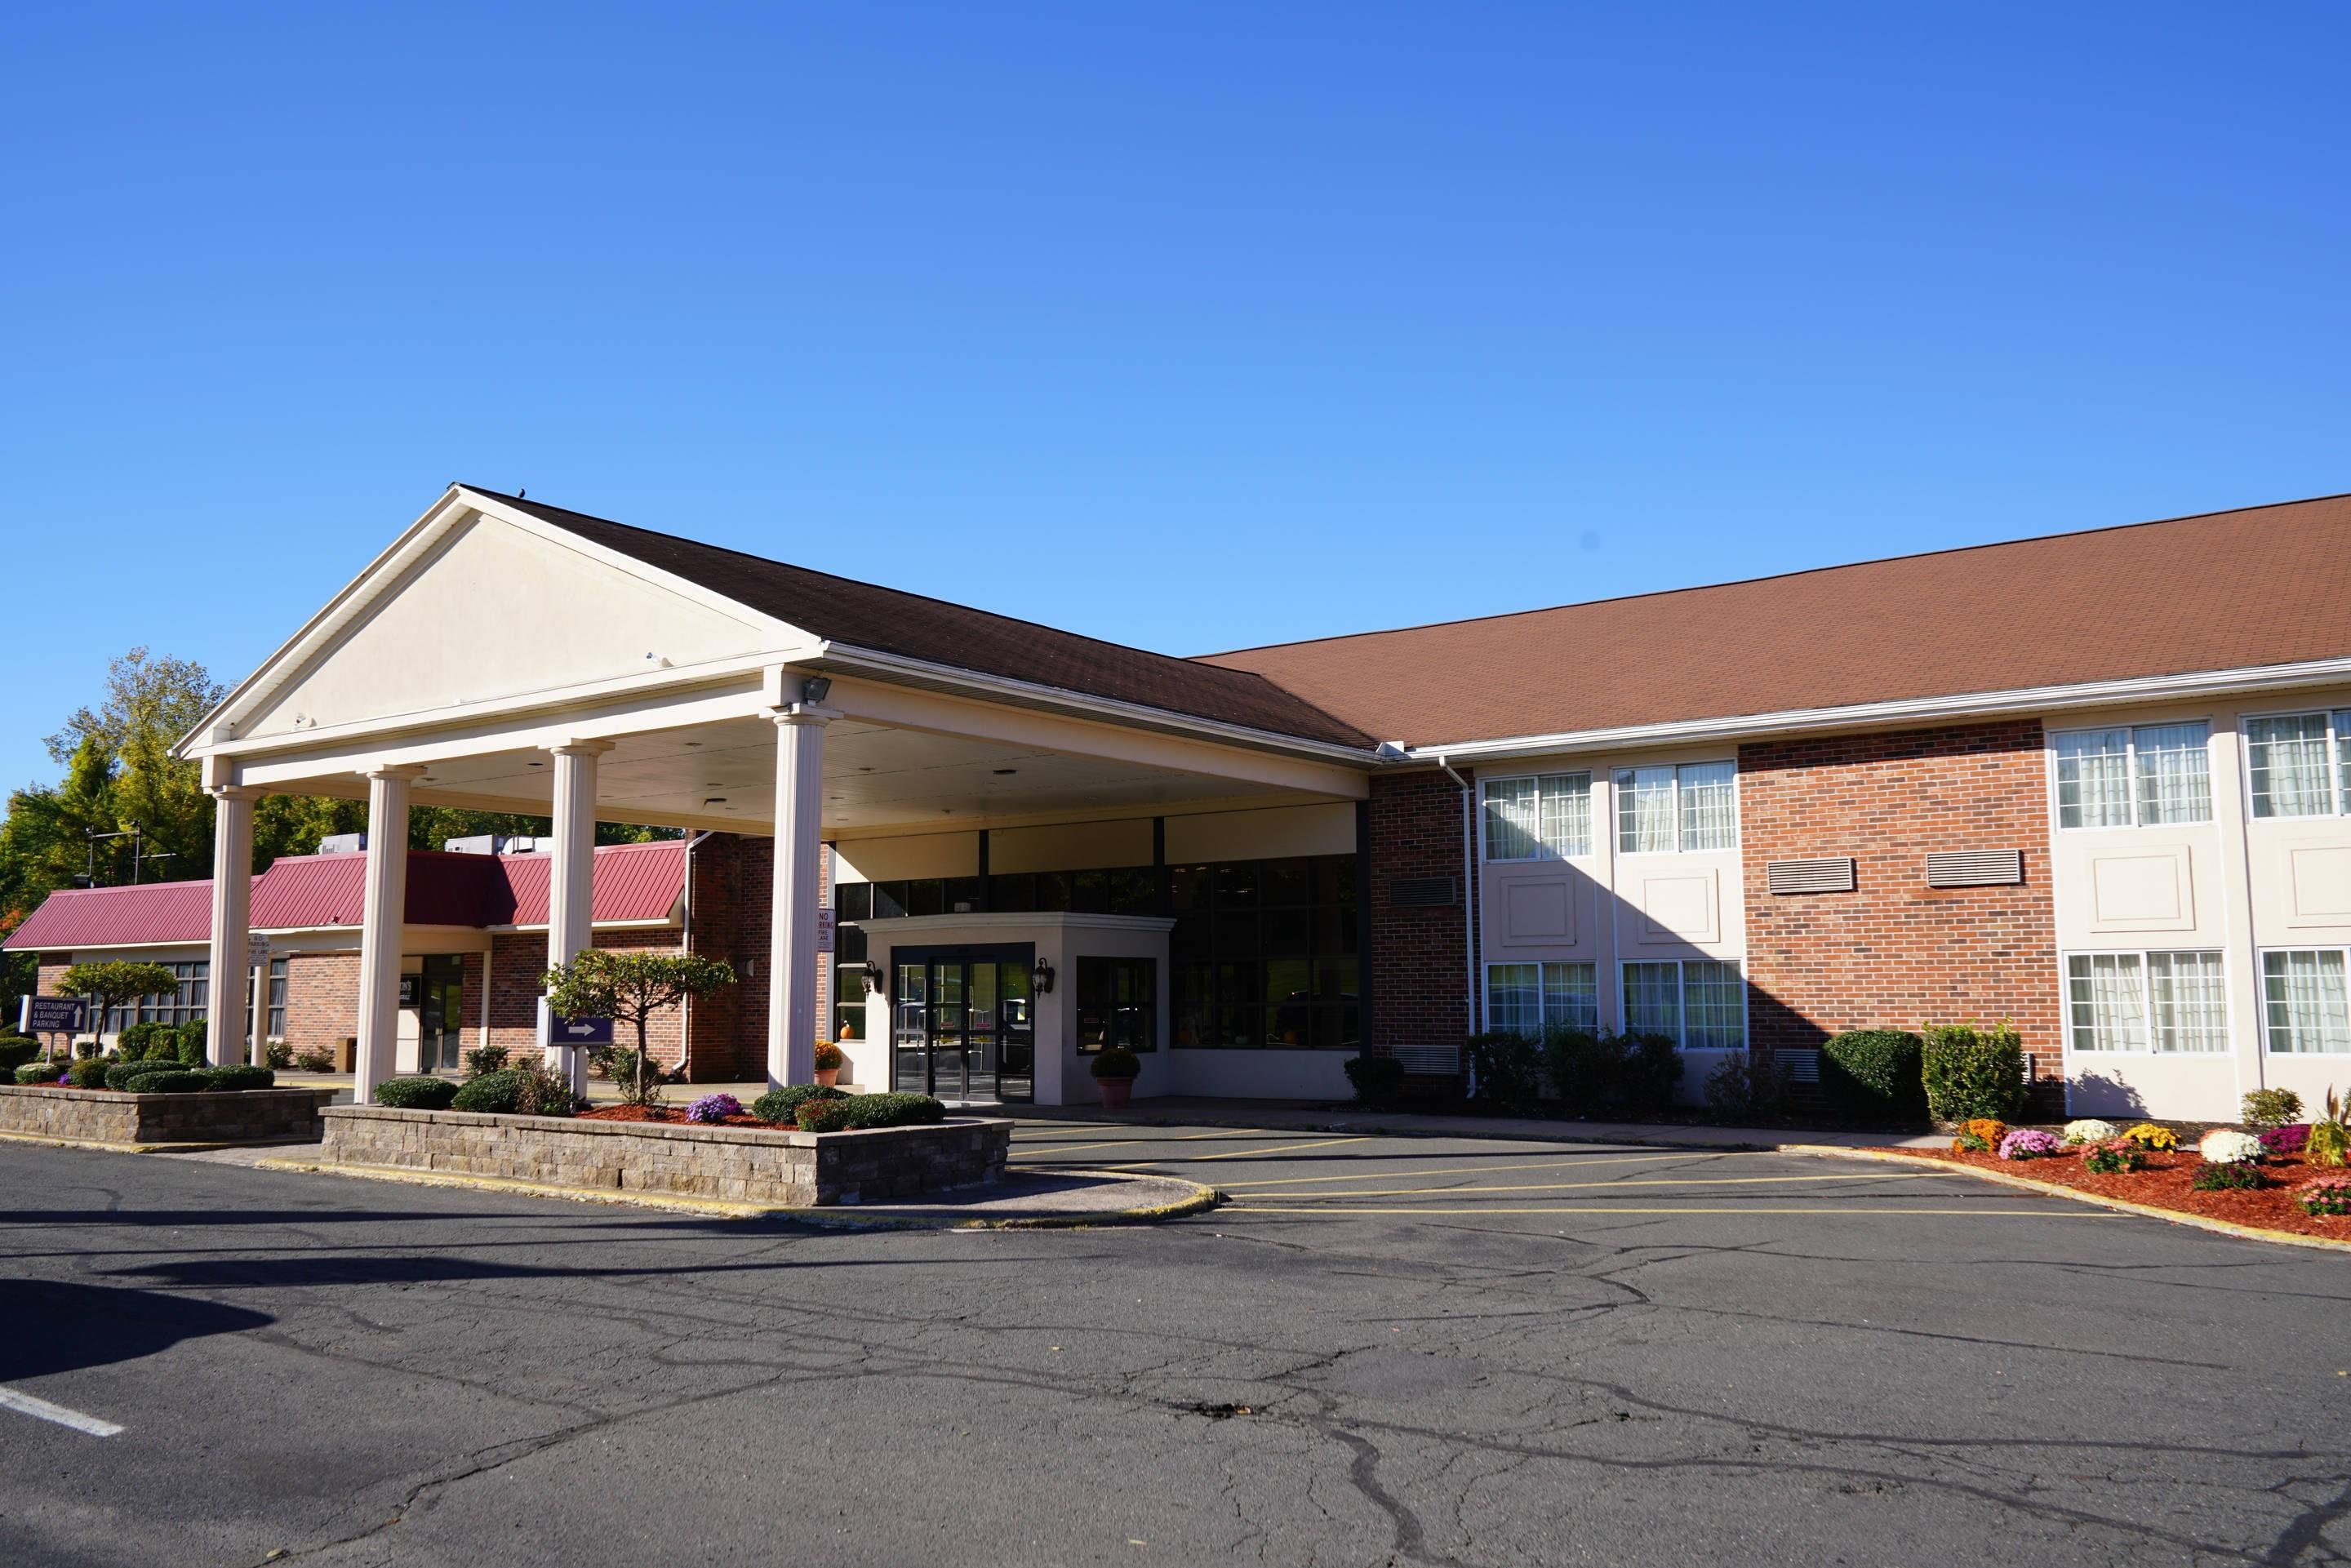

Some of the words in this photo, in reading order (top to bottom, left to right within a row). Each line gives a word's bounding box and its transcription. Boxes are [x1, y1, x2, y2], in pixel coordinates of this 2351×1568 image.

[819, 913, 829, 921] NO
[34, 1002, 75, 1011] RESTAURANT
[33, 1011, 38, 1019] &
[39, 1011, 69, 1019] BANQUET
[33, 1019, 60, 1028] PARKING
